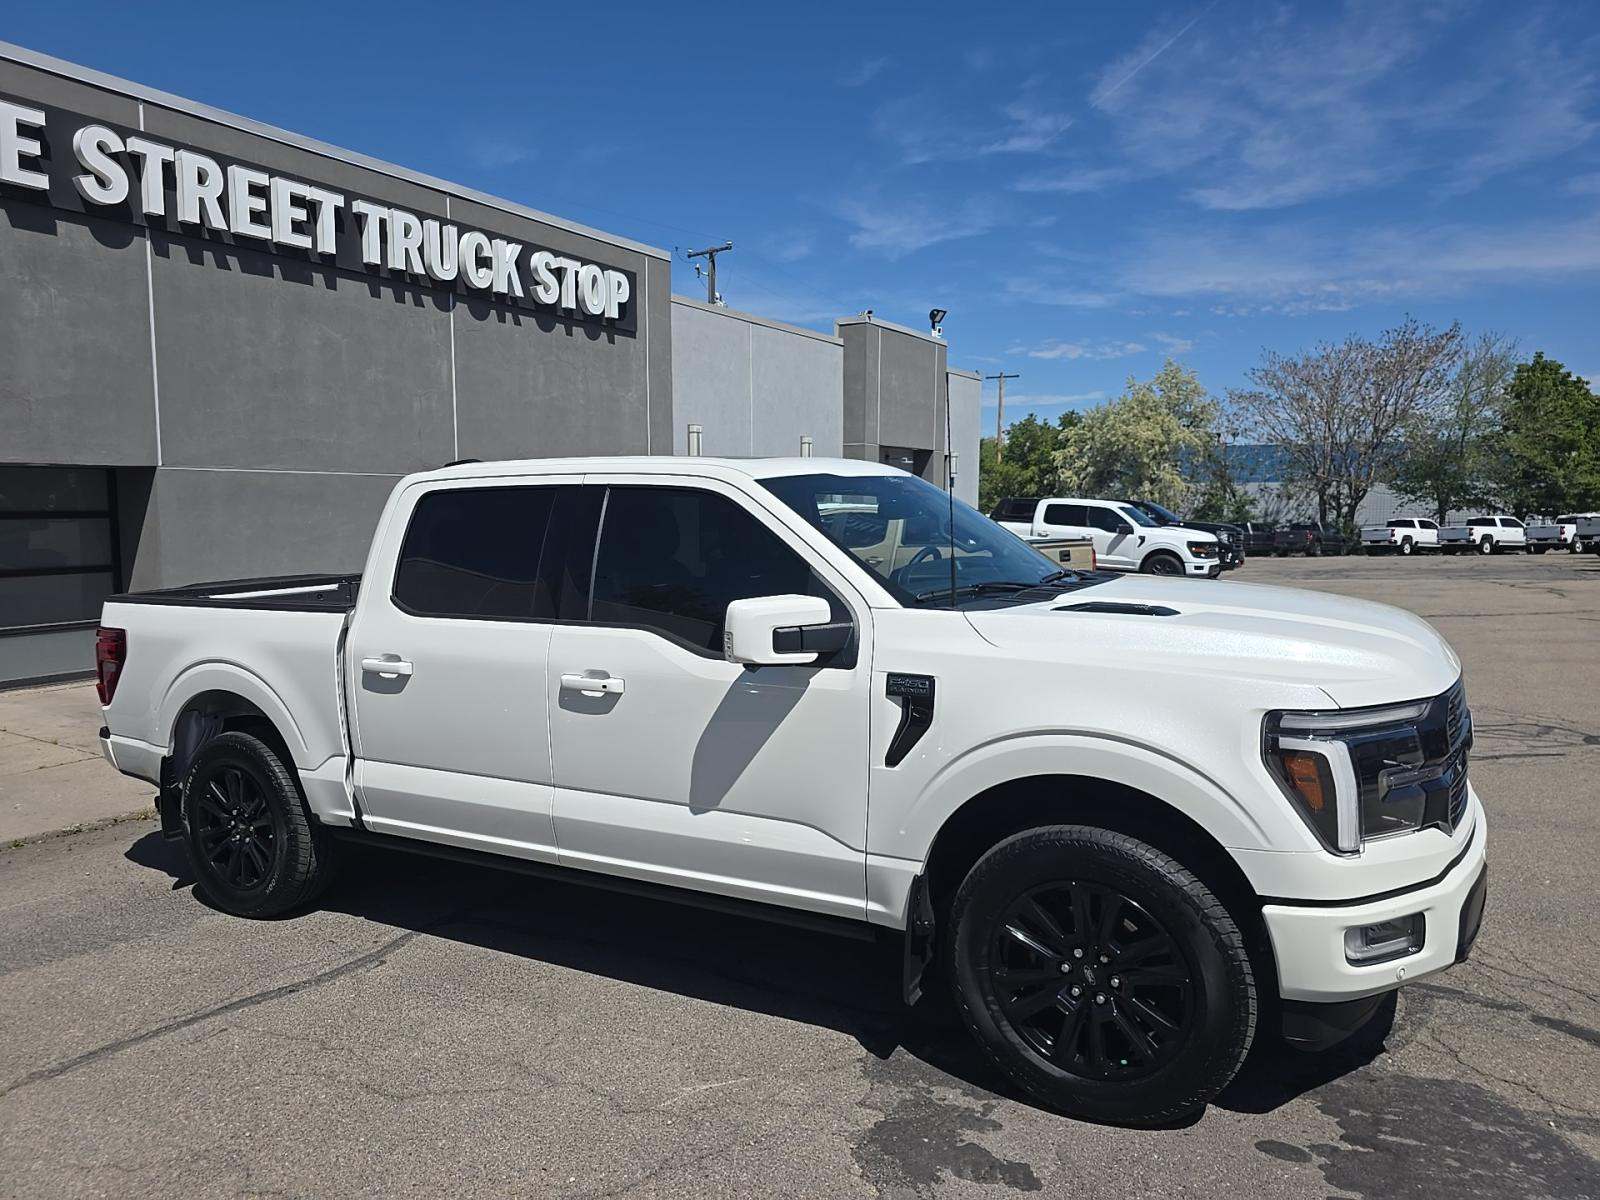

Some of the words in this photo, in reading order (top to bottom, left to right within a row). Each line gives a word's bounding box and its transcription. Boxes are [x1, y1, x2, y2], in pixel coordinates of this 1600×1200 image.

[72, 124, 344, 255] STREET
[352, 199, 524, 297] TRUCK
[529, 251, 630, 319] STOP
